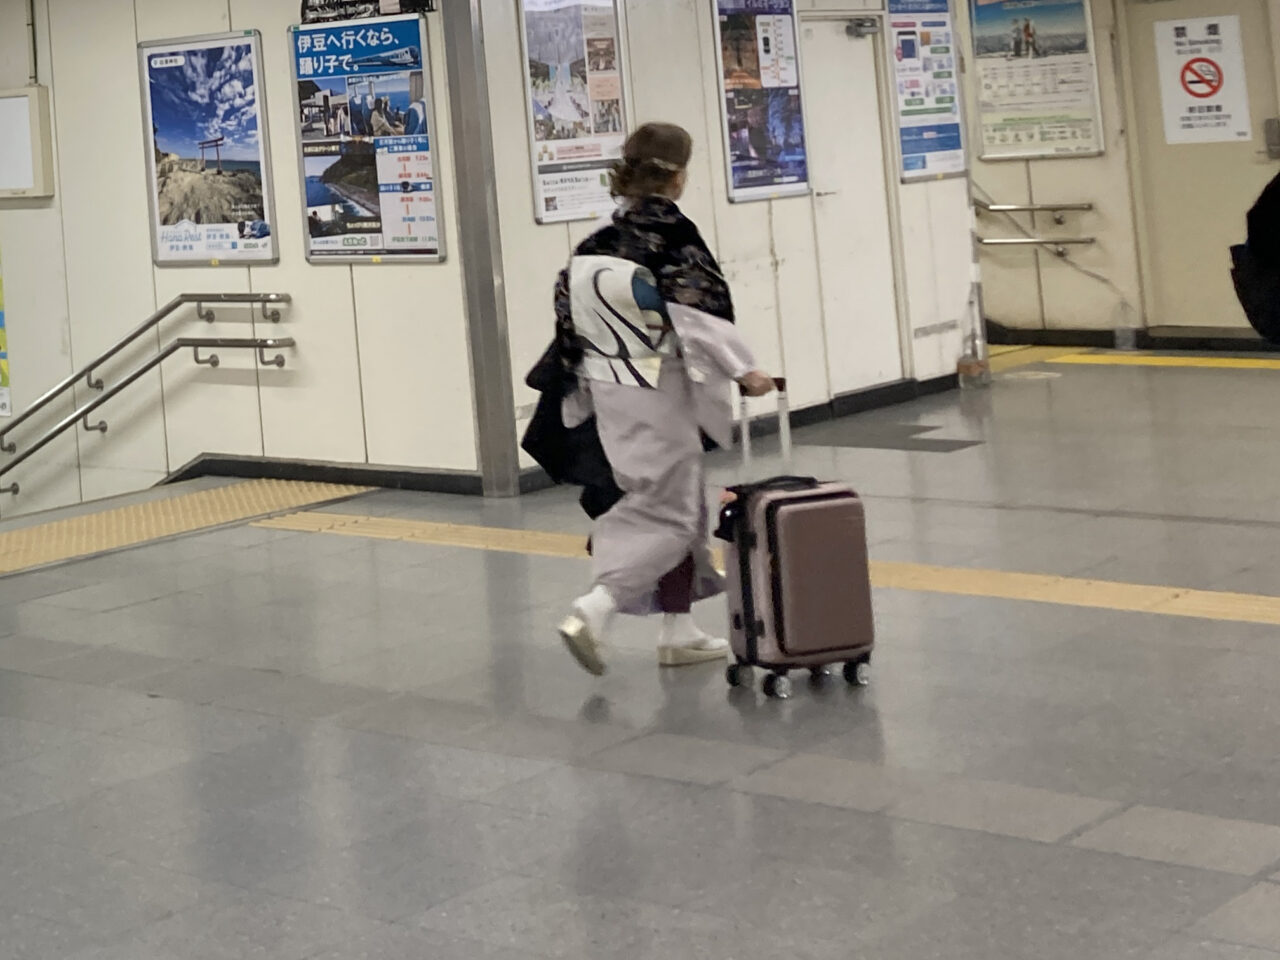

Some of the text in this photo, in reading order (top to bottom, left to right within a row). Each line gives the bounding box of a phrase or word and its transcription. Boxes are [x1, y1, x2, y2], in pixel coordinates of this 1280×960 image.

[298, 27, 399, 53] 伊豆へ行くなら、
[299, 54, 359, 75] 踊り子で。
